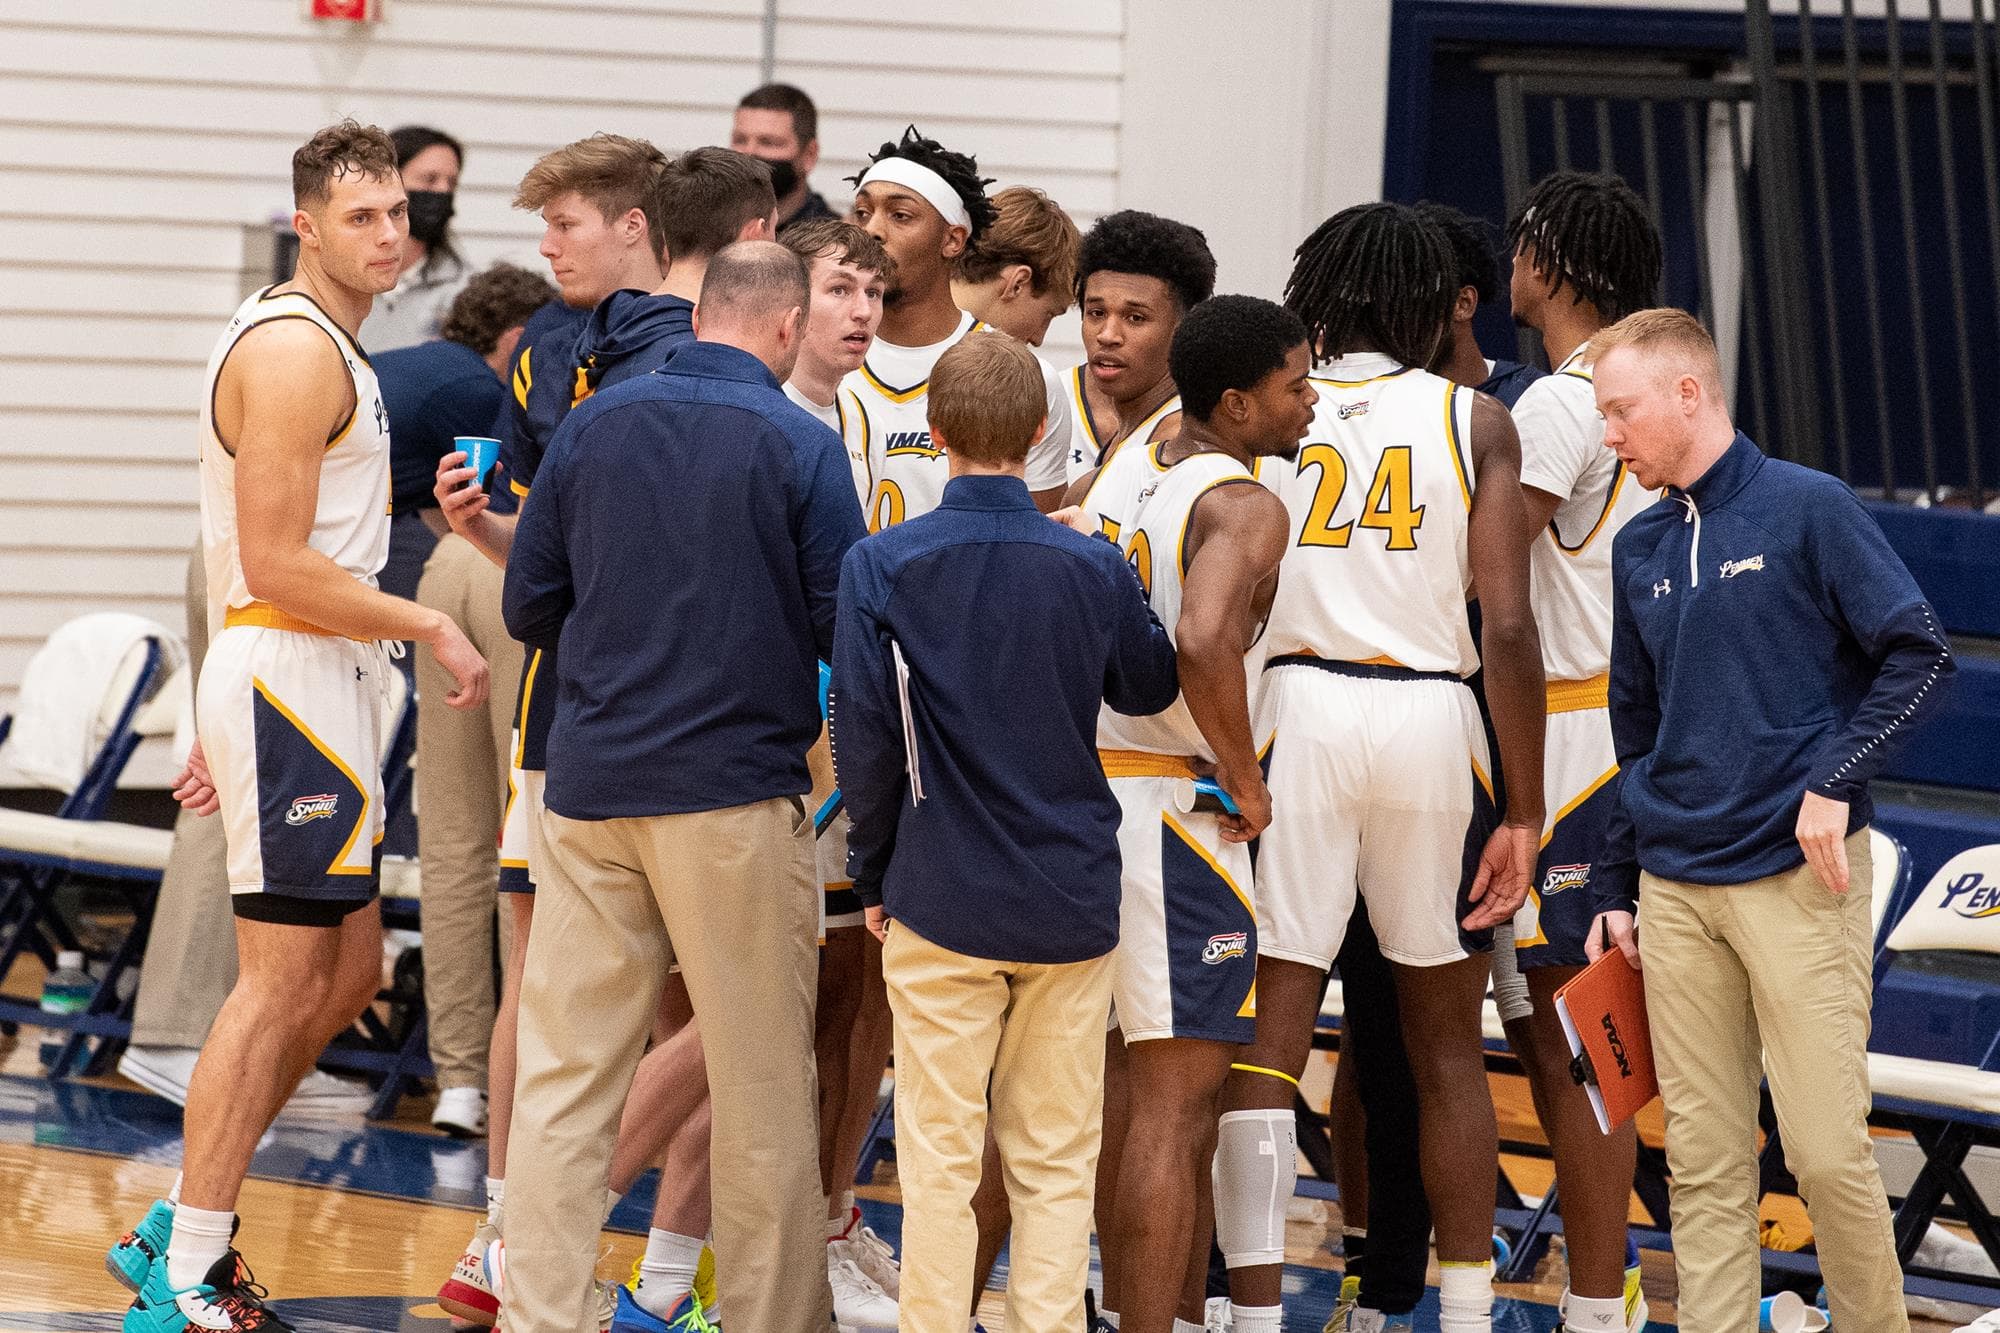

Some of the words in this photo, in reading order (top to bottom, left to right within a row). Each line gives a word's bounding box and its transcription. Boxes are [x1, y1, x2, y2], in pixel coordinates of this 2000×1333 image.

[1296, 443, 1426, 551] 24
[288, 801, 336, 821] SNHU
[1543, 869, 1588, 891] SNHU
[1204, 939, 1246, 960] SNHU
[1601, 1012, 1632, 1078] NCAA
